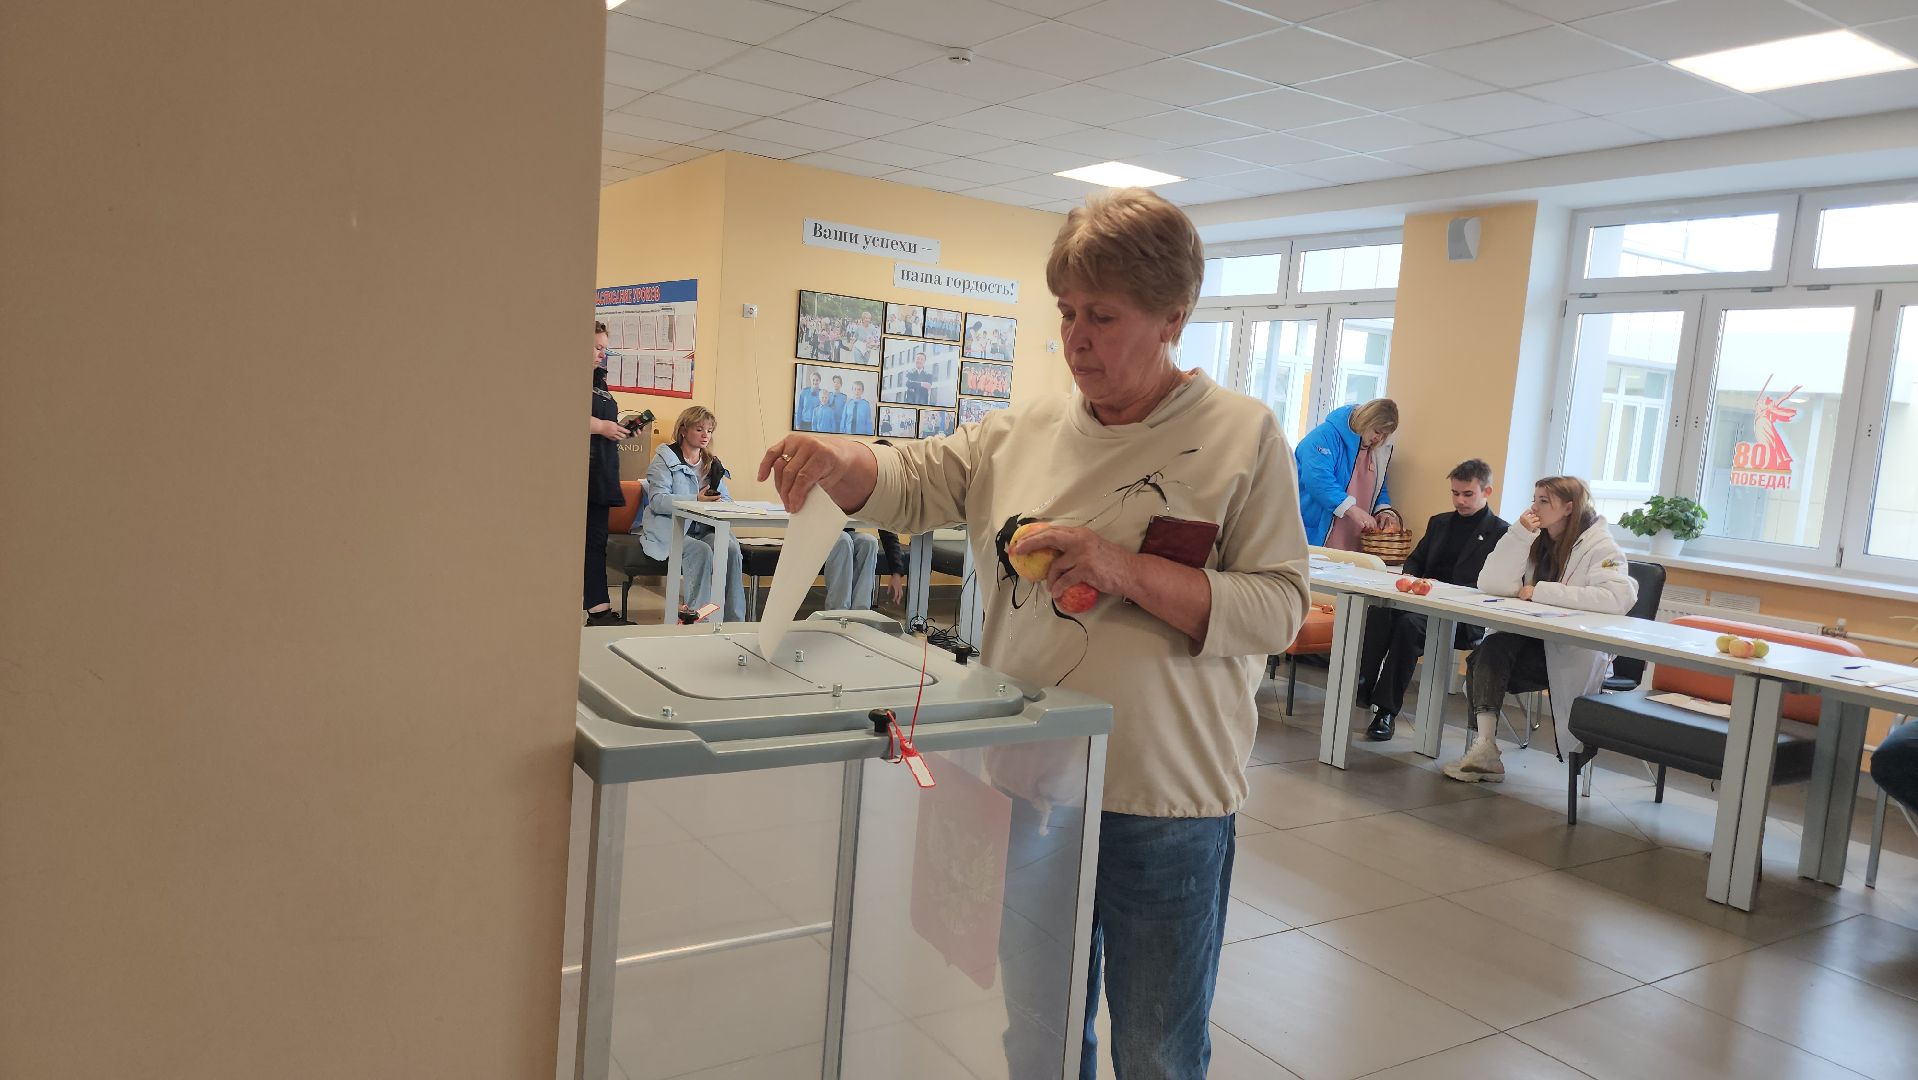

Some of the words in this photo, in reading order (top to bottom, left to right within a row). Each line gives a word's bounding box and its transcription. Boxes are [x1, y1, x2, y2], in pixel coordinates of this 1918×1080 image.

[813, 222, 859, 244] Ваши
[863, 234, 917, 254] успехи
[900, 269, 943, 286] наша
[946, 276, 1014, 296] гордость!
[595, 289, 631, 305] АСПИСАНИЕ
[632, 285, 660, 303] УРОКОВ
[616, 443, 643, 452] ANDI
[1734, 442, 1767, 469] 80
[1731, 472, 1791, 490] ПОБЕДА!
